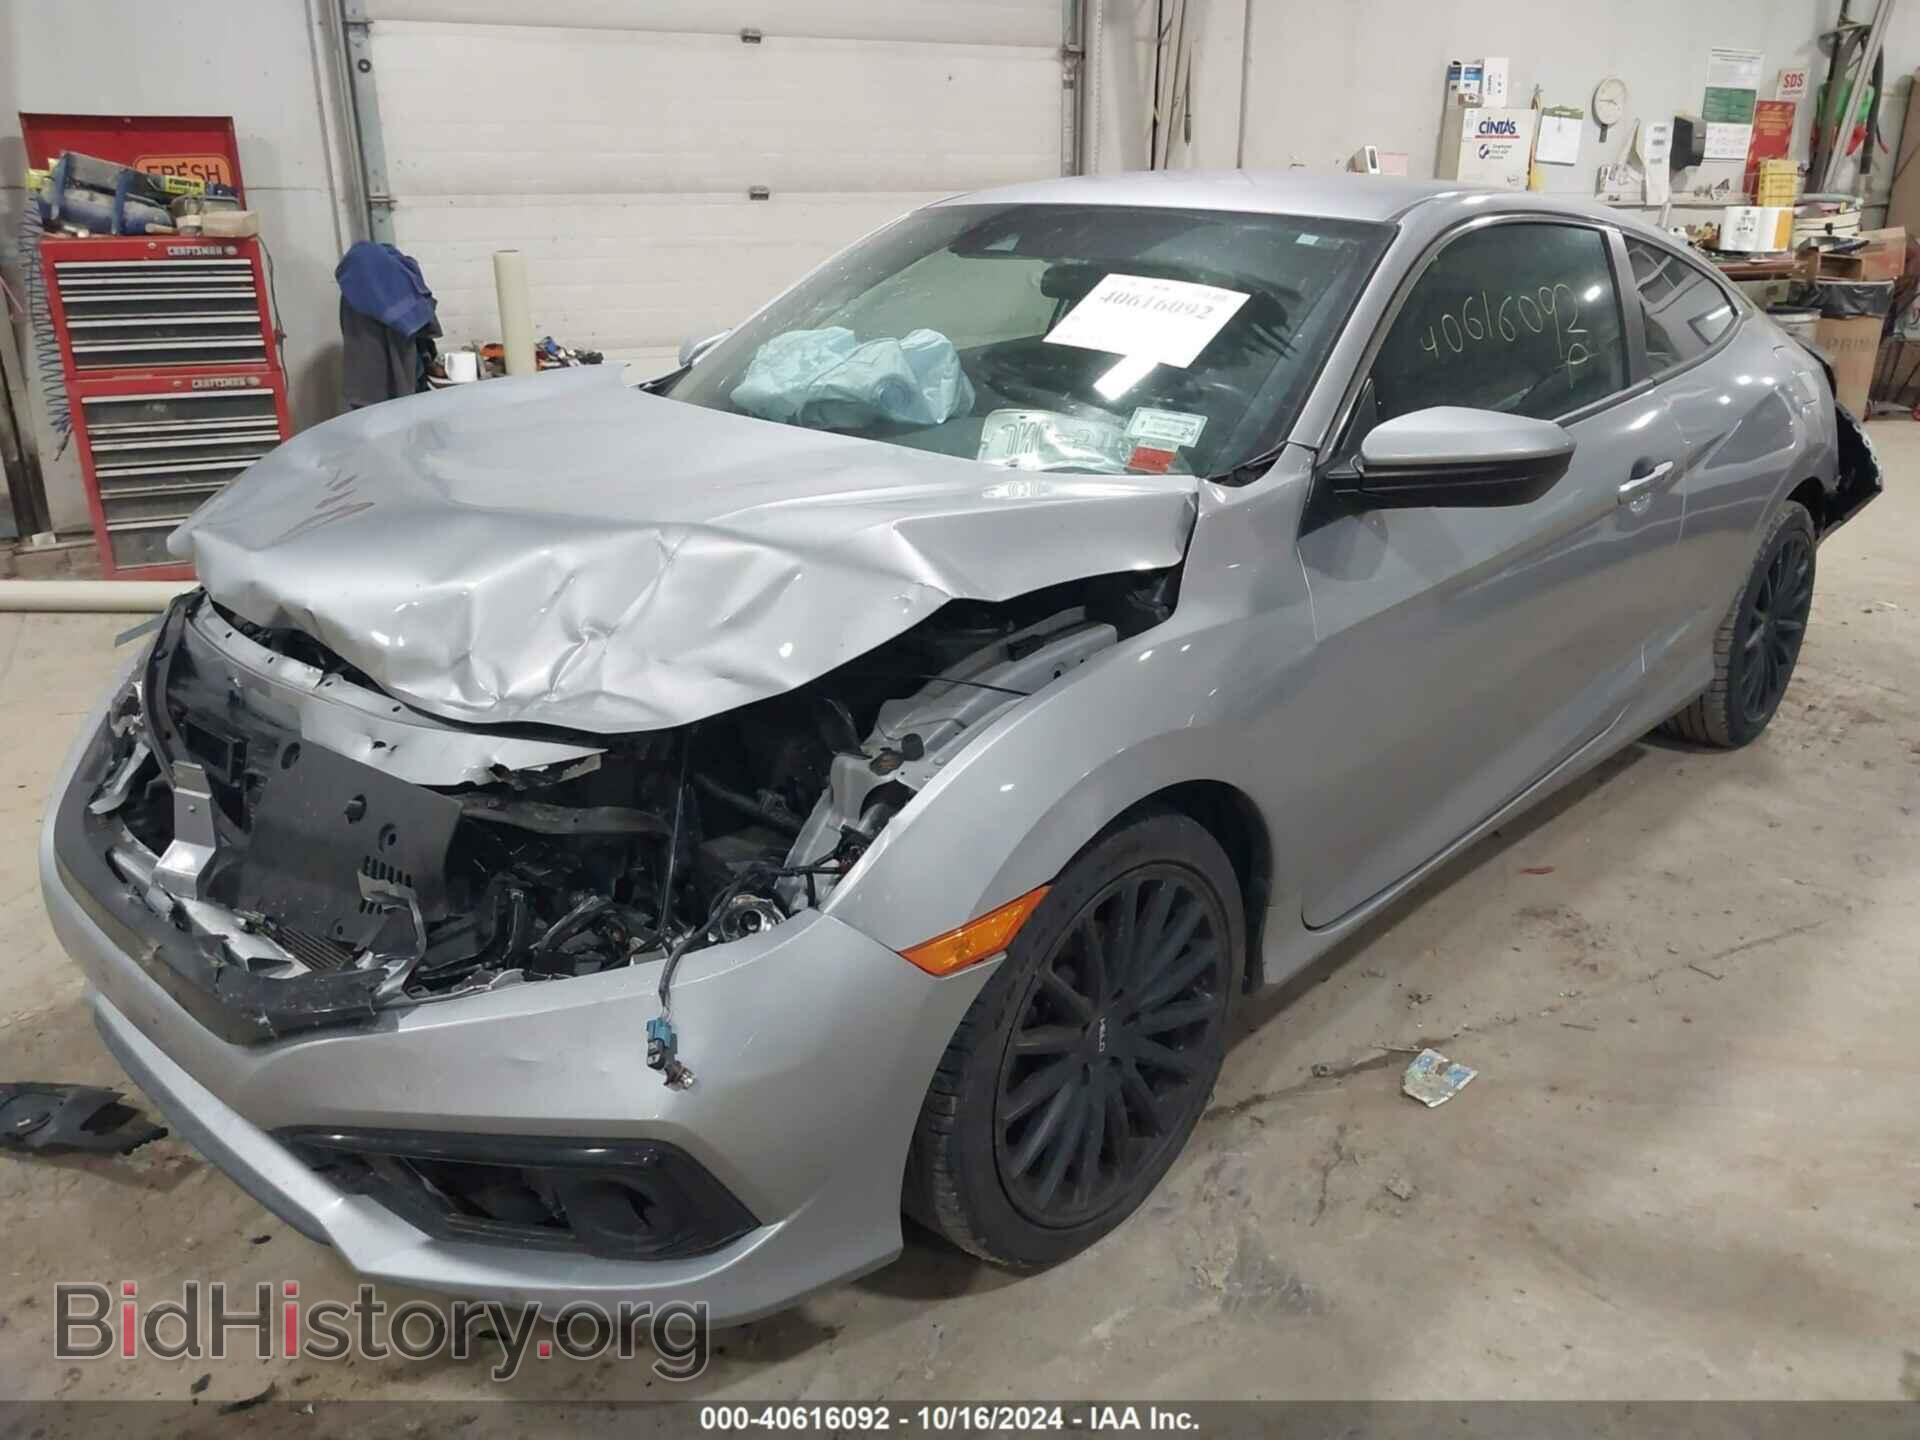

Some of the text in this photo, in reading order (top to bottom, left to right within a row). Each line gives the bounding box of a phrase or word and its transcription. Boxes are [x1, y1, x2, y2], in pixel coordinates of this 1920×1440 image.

[1783, 73, 1804, 88] SDS
[1478, 116, 1517, 135] CINTAS
[1101, 290, 1215, 320] 40616092
[1420, 283, 1588, 359] 40616092
